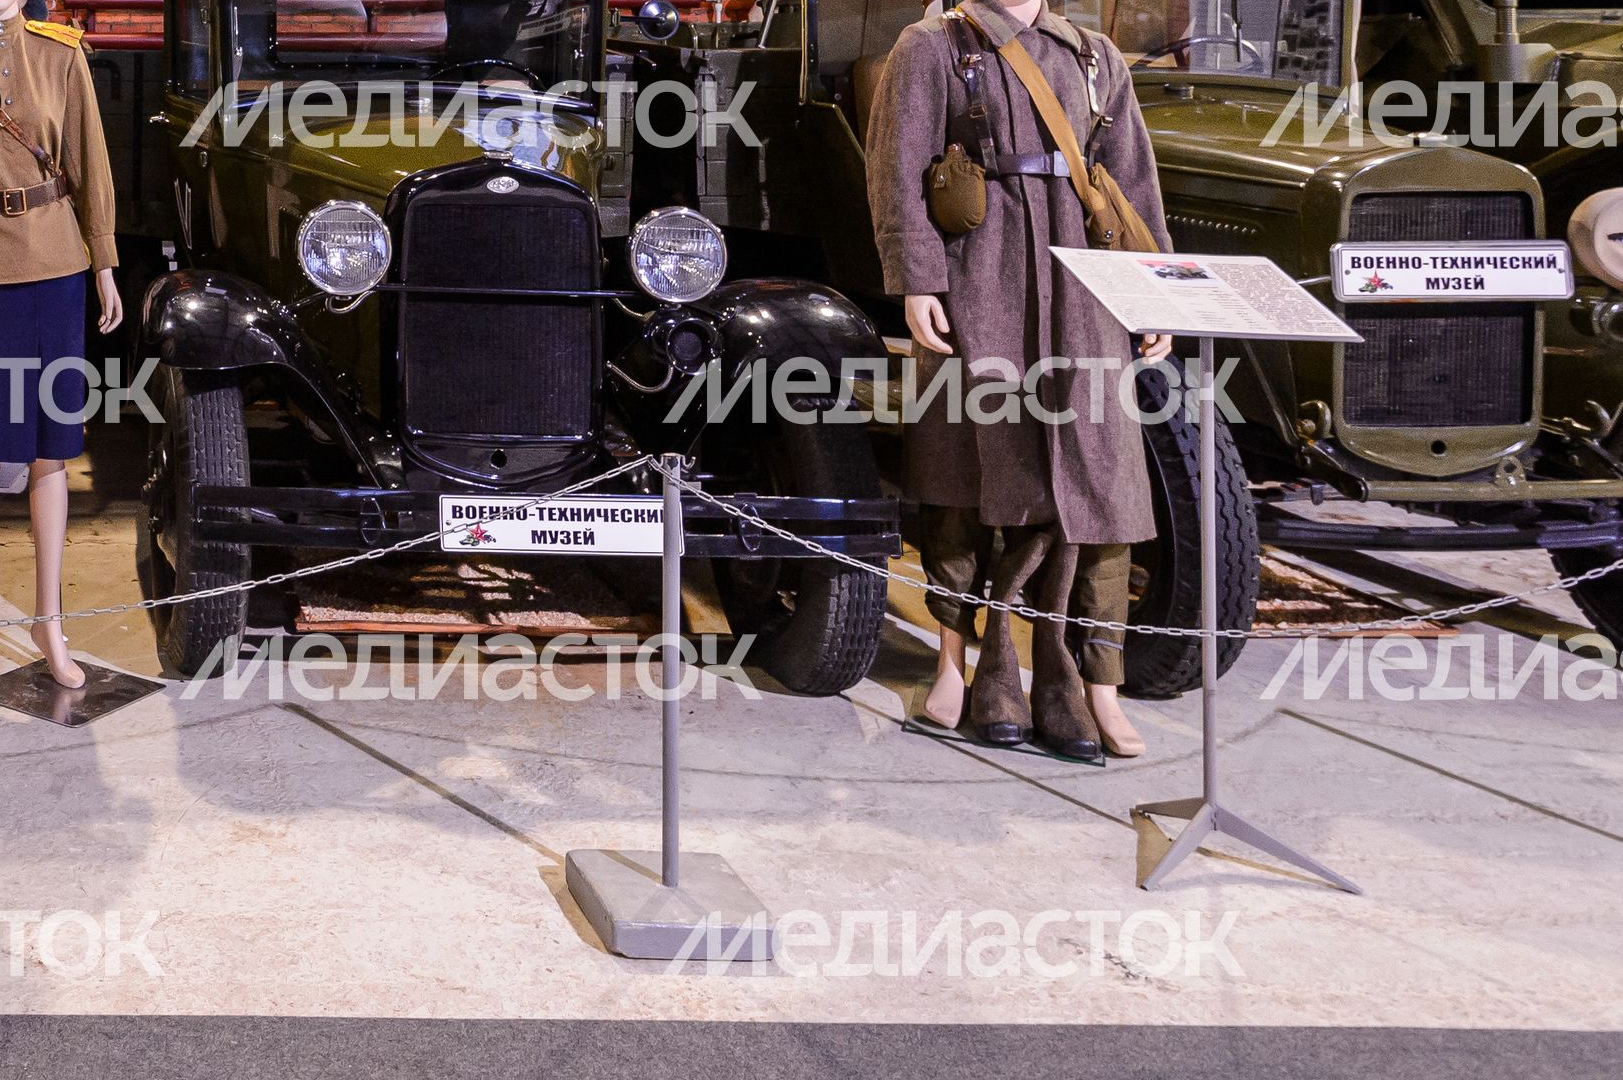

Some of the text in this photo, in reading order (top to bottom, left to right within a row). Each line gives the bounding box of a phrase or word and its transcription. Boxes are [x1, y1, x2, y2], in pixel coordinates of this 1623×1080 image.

[1351, 253, 1558, 270] ВОЕННО-ТЕХНИЧЕСКИЙ
[1425, 275, 1485, 291] МУЗЕЙ
[530, 528, 596, 546] МУЗЕЙ
